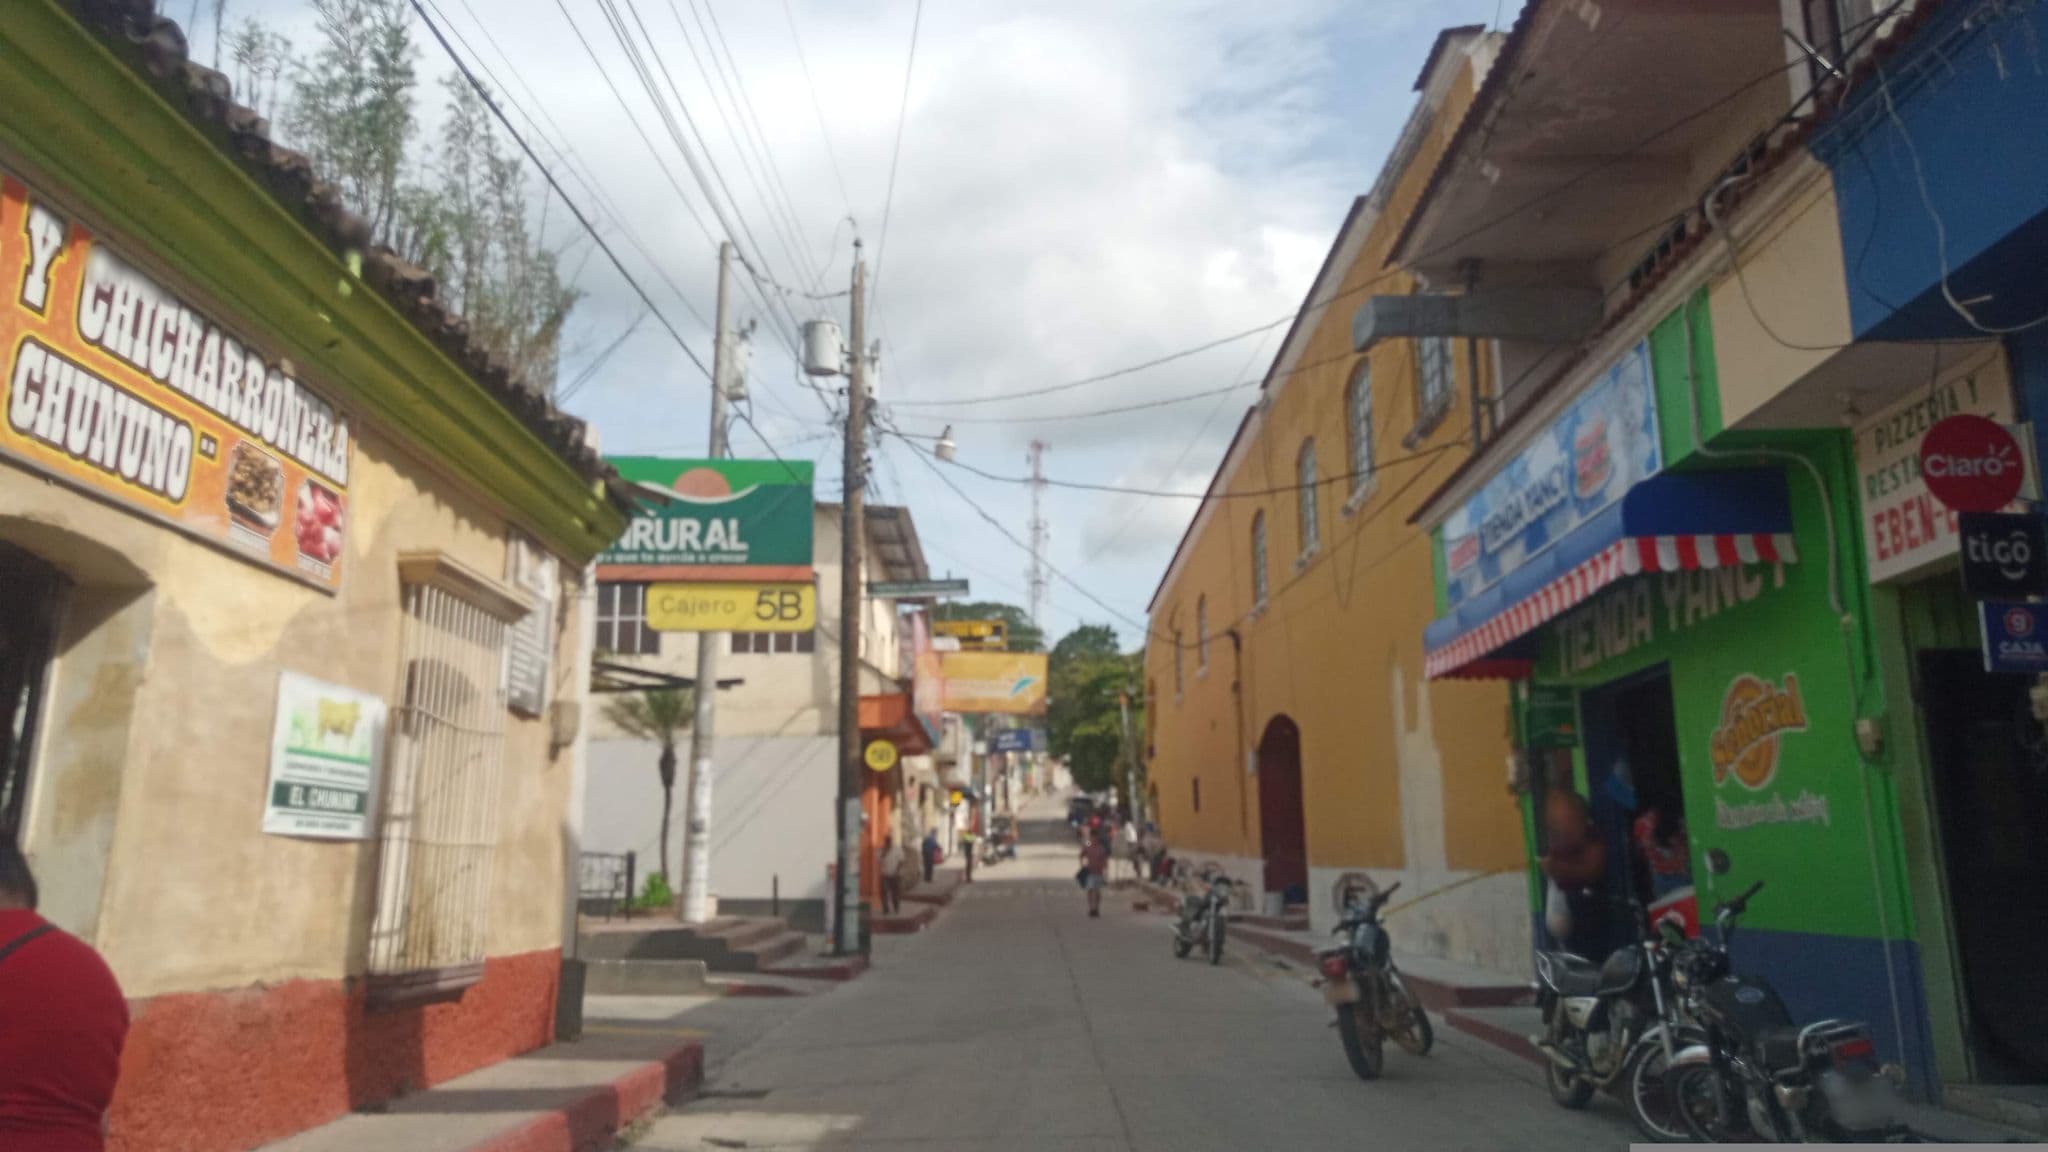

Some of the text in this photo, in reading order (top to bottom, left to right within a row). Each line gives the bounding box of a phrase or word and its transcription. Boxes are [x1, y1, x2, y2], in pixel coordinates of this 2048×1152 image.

[22, 204, 349, 487] Y CHICHARRONERA
[1874, 384, 1960, 454] PIZZERIA
[1924, 453, 2003, 477] Claro
[659, 589, 803, 621] Cajero 5B
[1555, 577, 1654, 676] TIENDA
[289, 785, 304, 807] EL
